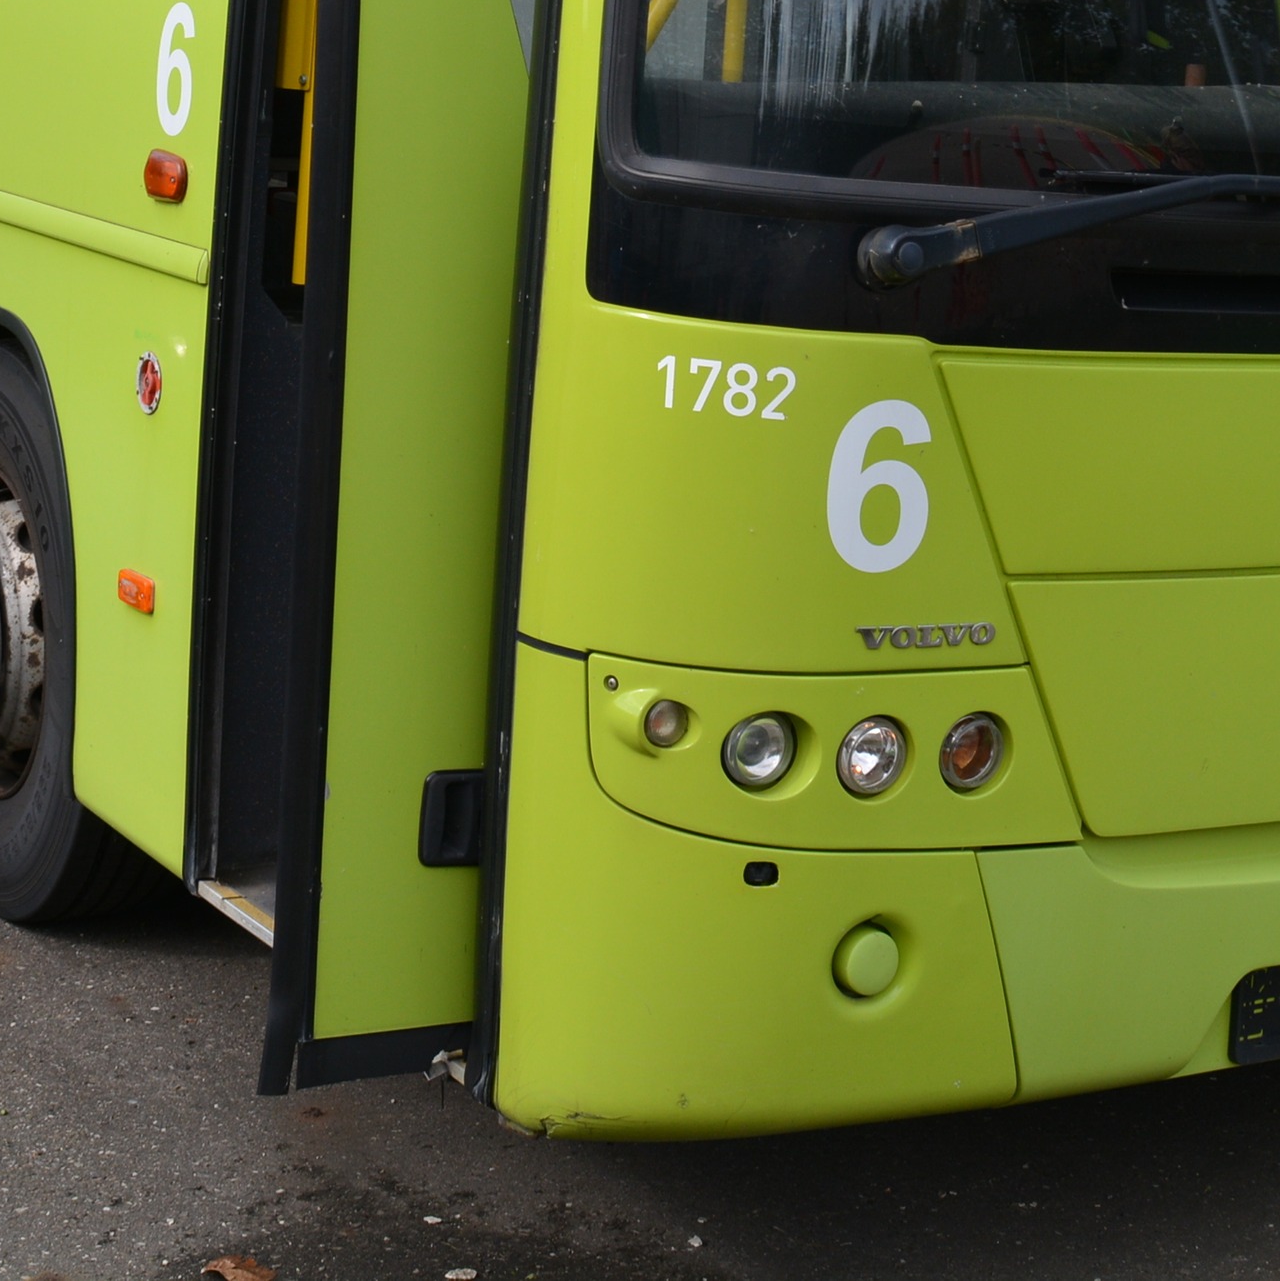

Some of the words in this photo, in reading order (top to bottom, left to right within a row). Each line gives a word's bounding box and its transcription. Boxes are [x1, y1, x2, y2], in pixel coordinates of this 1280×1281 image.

[156, 1, 196, 137] 6
[656, 354, 797, 421] 1782
[826, 399, 932, 574] 6
[855, 622, 996, 650] VOLVO
